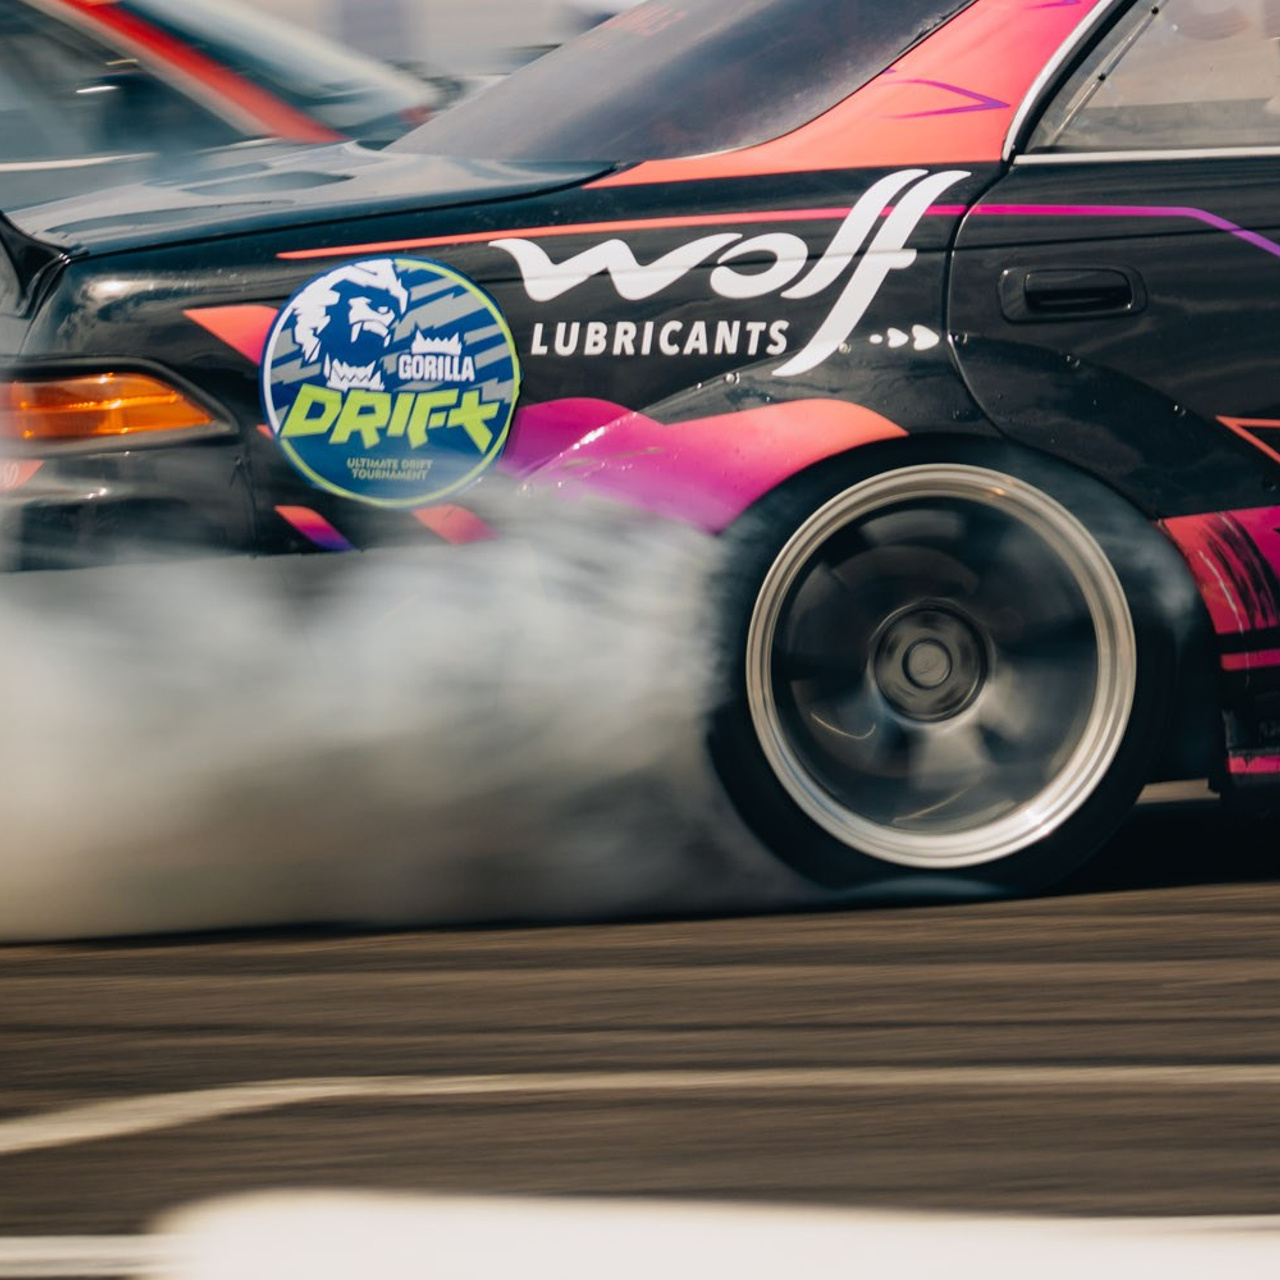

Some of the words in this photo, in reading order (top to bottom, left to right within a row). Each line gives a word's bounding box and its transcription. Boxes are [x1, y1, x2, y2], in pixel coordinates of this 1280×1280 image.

[488, 168, 972, 377] wolf
[531, 320, 790, 356] LUBRICANTS
[398, 354, 476, 382] GORILLA
[279, 382, 500, 455] DRIFT
[346, 457, 398, 470] ULTIMATE
[401, 458, 433, 470] DRIFT
[352, 468, 428, 480] TOURNAMENT
